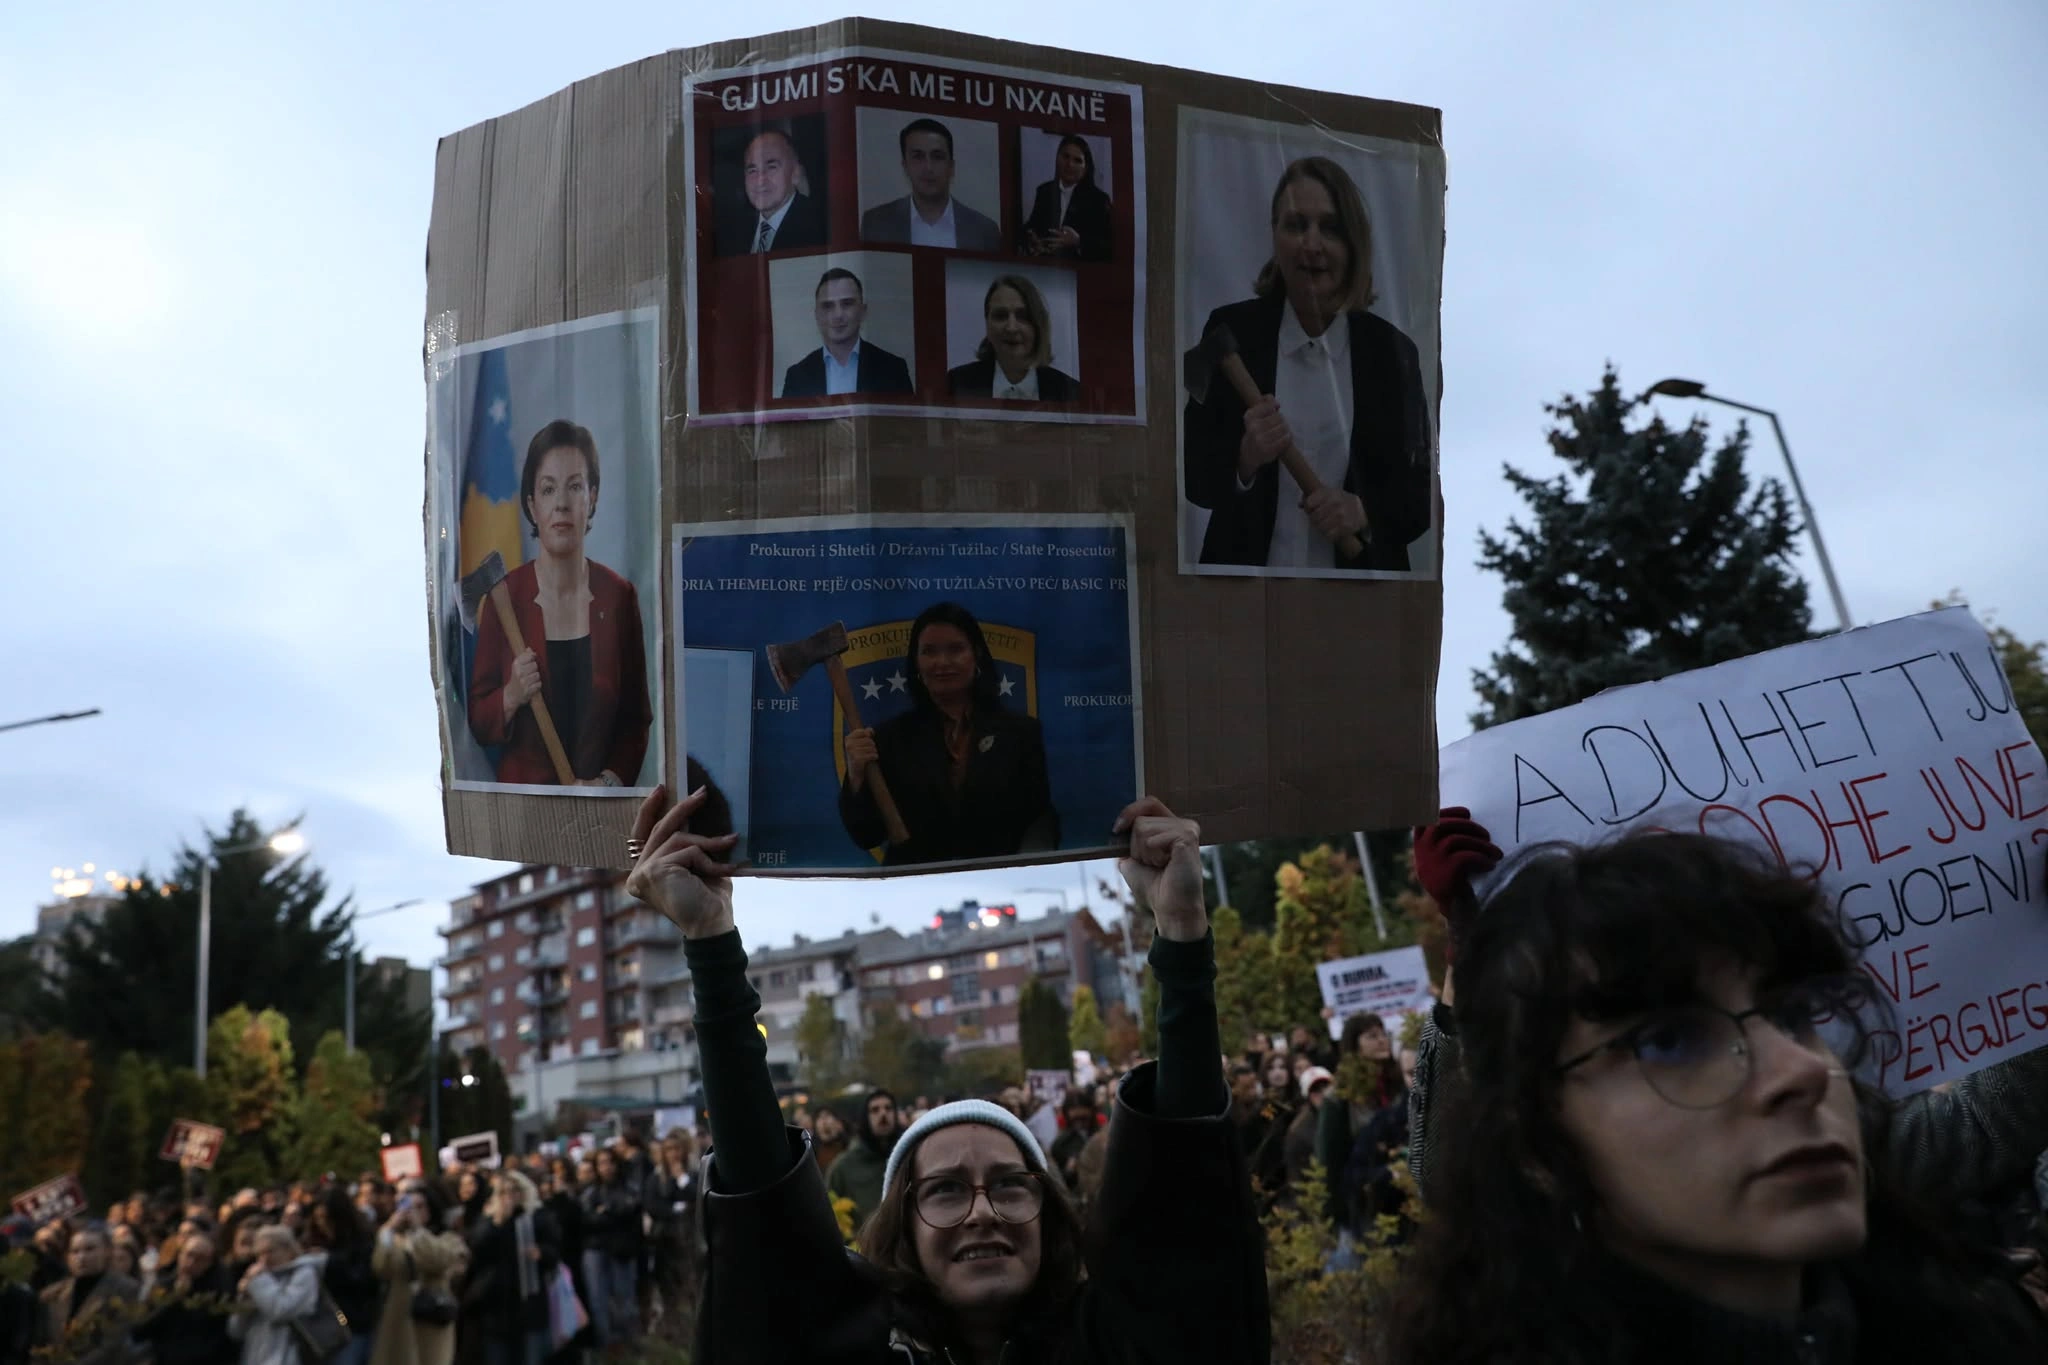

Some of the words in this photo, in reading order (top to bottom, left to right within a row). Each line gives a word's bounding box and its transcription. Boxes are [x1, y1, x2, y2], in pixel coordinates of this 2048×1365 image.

[721, 72, 818, 112] GJUMI
[909, 71, 956, 102] ME
[965, 78, 994, 107] IU
[1005, 84, 1106, 123] NXANË
[749, 543, 816, 557] Prokurori
[820, 543, 824, 557] i
[828, 543, 876, 557] Shtetit
[887, 542, 945, 556] Državni
[948, 542, 999, 556] Tužilac
[1010, 542, 1045, 556] State
[1047, 543, 1117, 557] Prosecutor
[718, 578, 807, 592] THEMELORE
[851, 577, 930, 591] OSNOVNO
[933, 575, 1026, 590] TUŽILAŠTVO
[1062, 577, 1103, 590] BASIC
[770, 696, 799, 712] PEJË
[1919, 740, 2048, 844] JUVE
[758, 849, 787, 867] PEJË
[1856, 944, 1940, 1003] VE
[1866, 980, 2048, 1088] PËRGJEG
